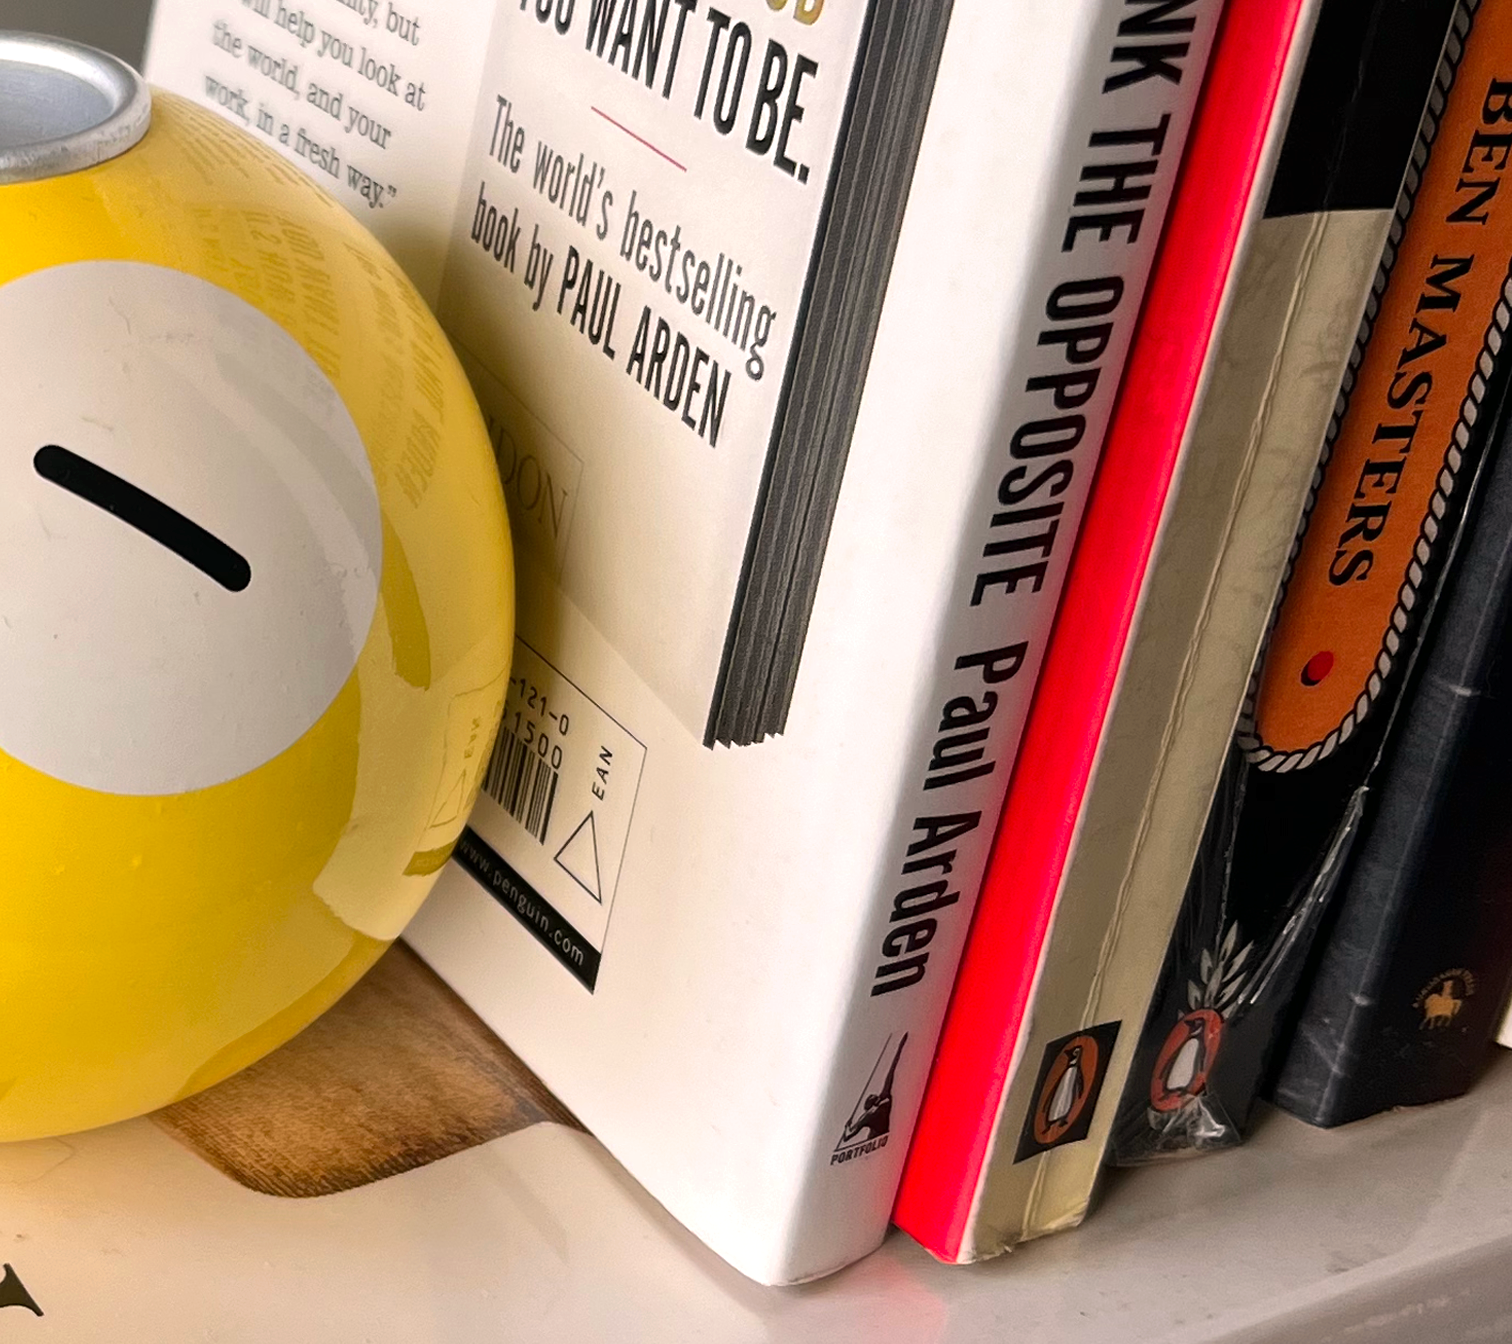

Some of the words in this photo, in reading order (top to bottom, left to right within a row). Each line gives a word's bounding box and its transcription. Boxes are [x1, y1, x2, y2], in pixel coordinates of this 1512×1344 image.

[213, 21, 242, 57] the
[247, 45, 300, 99] world,
[307, 82, 343, 120] and
[345, 106, 391, 149] your
[318, 30, 353, 68] you
[358, 47, 401, 96] look
[405, 83, 425, 110] at
[386, 2, 420, 45] but
[694, 6, 752, 135] TO
[745, 39, 819, 184] BE.
[205, 76, 250, 125] work,
[257, 103, 273, 135] in
[279, 124, 289, 146] a
[294, 128, 339, 178] fresh
[1061, 112, 1172, 253] THE
[489, 94, 525, 175] The
[532, 140, 614, 242] world's
[620, 190, 776, 381] bestselling
[471, 181, 522, 273] book
[524, 224, 554, 312] by
[557, 245, 622, 361] PAUL
[626, 305, 733, 449] ARDEN
[969, 275, 1125, 607] OPPOSITE
[1327, 252, 1476, 587] MASTERS
[592, 745, 613, 802] EAN
[923, 640, 1029, 791] Paul
[869, 810, 982, 998] Arden
[830, 1135, 889, 1166] PORTFOLIO
